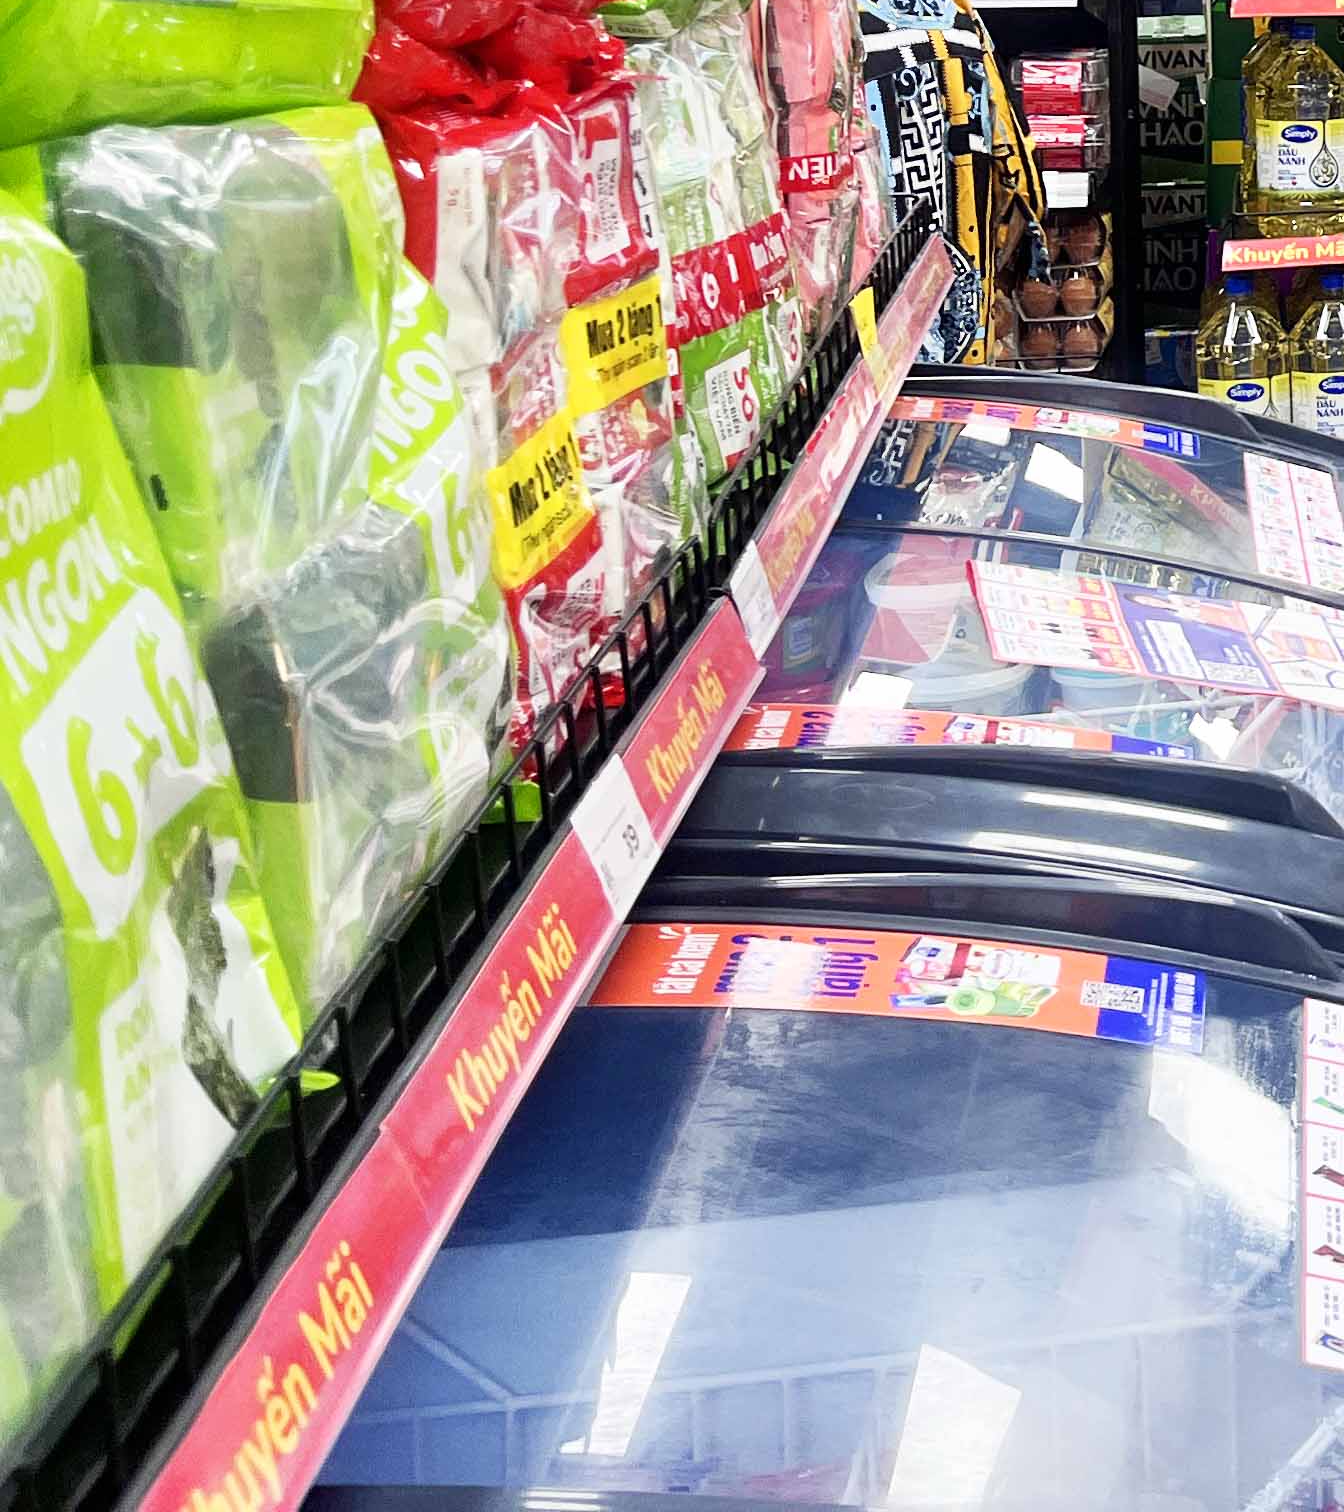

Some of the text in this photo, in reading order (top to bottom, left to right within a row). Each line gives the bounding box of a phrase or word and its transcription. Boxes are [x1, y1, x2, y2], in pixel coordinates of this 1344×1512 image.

[1230, 240, 1309, 266] Khuyến
[617, 308, 626, 344] 2
[645, 658, 728, 804] Khuyến Mãi
[444, 901, 578, 1131] Khuyến Mãi
[301, 1240, 375, 1381] Mãi
